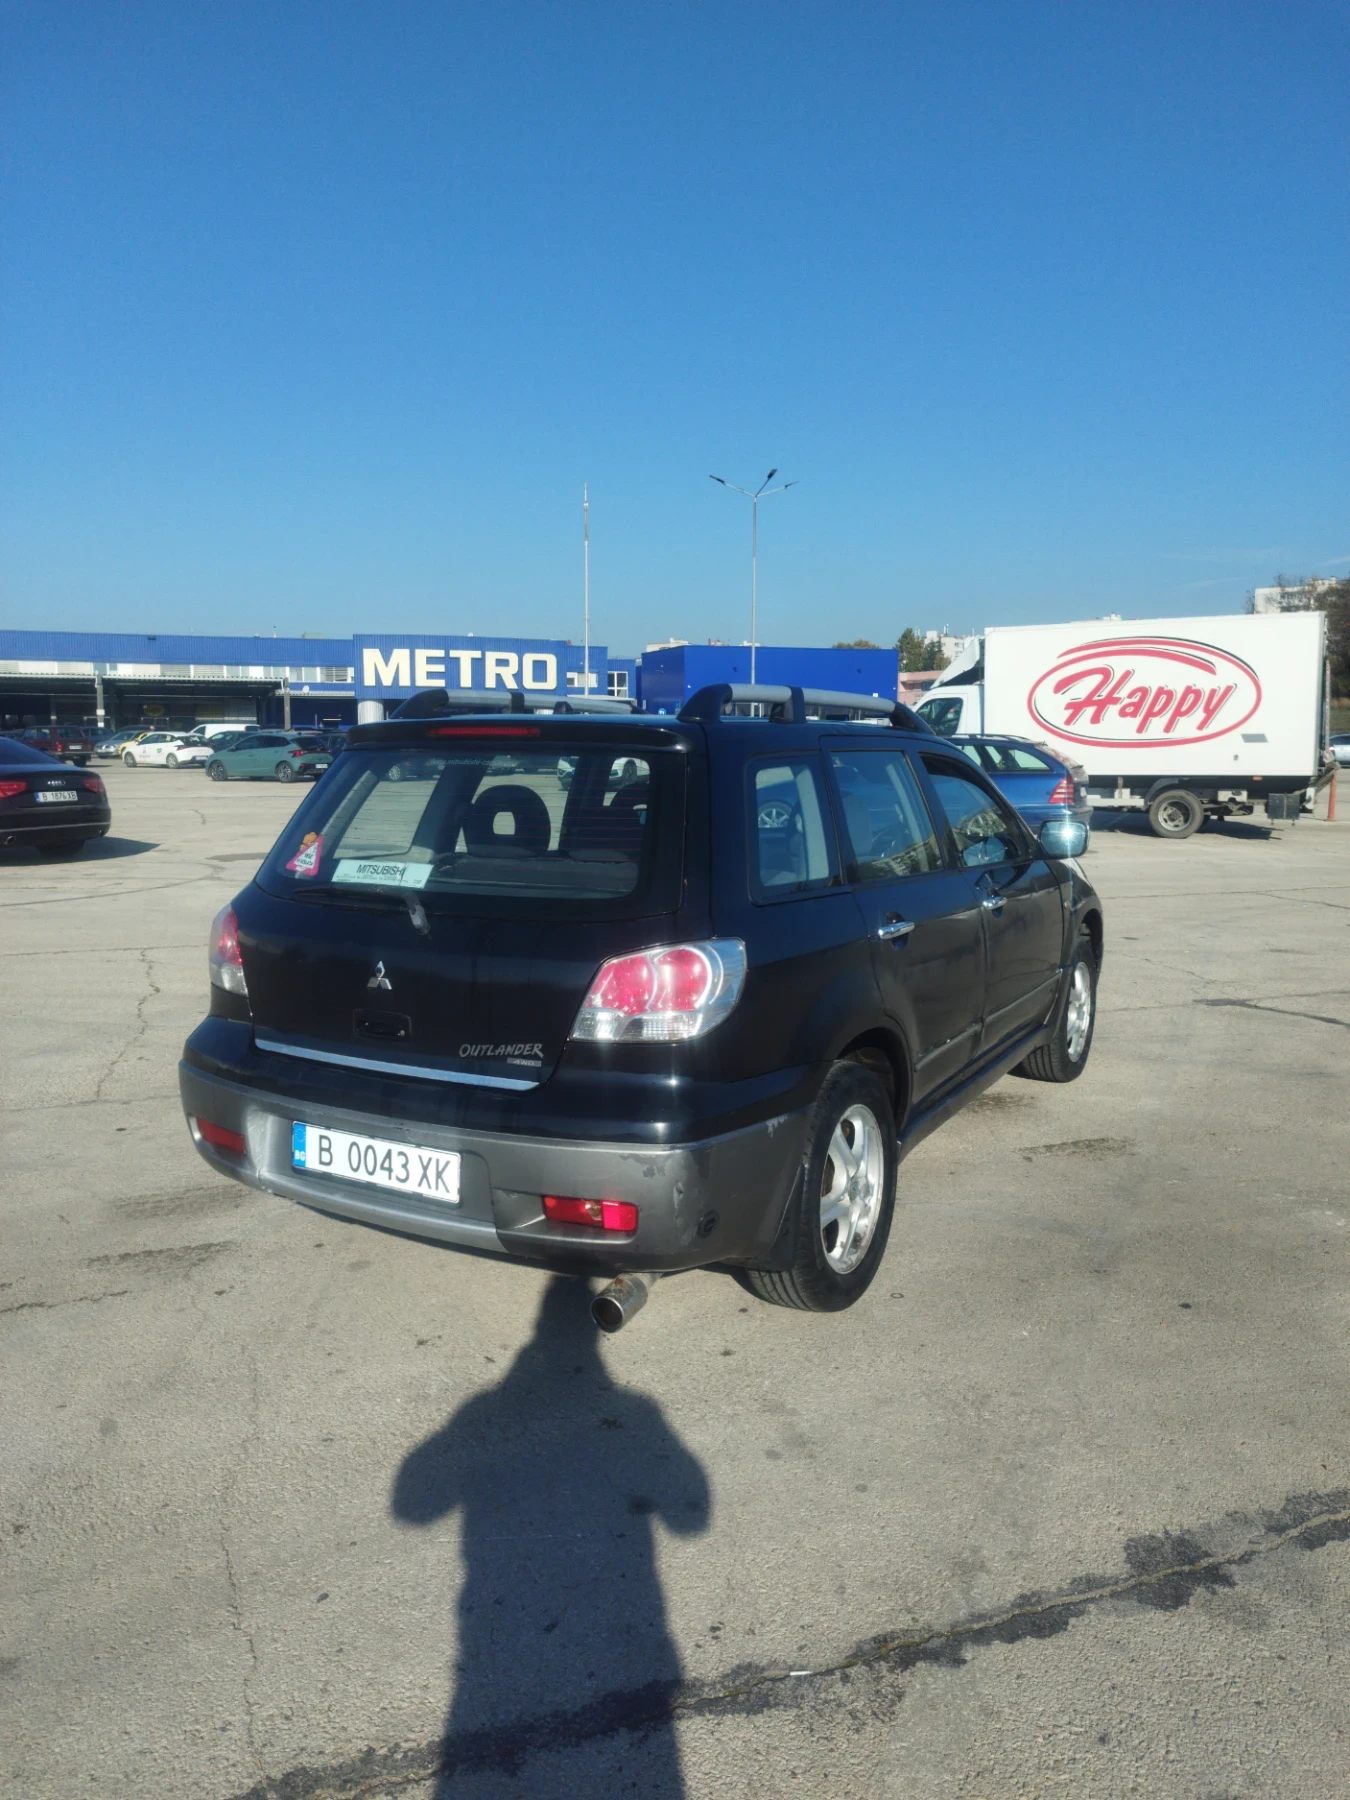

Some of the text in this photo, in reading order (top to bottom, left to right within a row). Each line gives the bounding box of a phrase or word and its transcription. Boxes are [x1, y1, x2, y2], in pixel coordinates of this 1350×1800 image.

[362, 648, 557, 690] METRO
[1052, 664, 1237, 734] Happy
[42, 792, 48, 801] B
[356, 864, 407, 876] MITSUBISHI
[458, 1043, 544, 1058] OUTLANDER
[294, 1150, 306, 1161] BG
[318, 1134, 451, 1193] B 0043 XK
